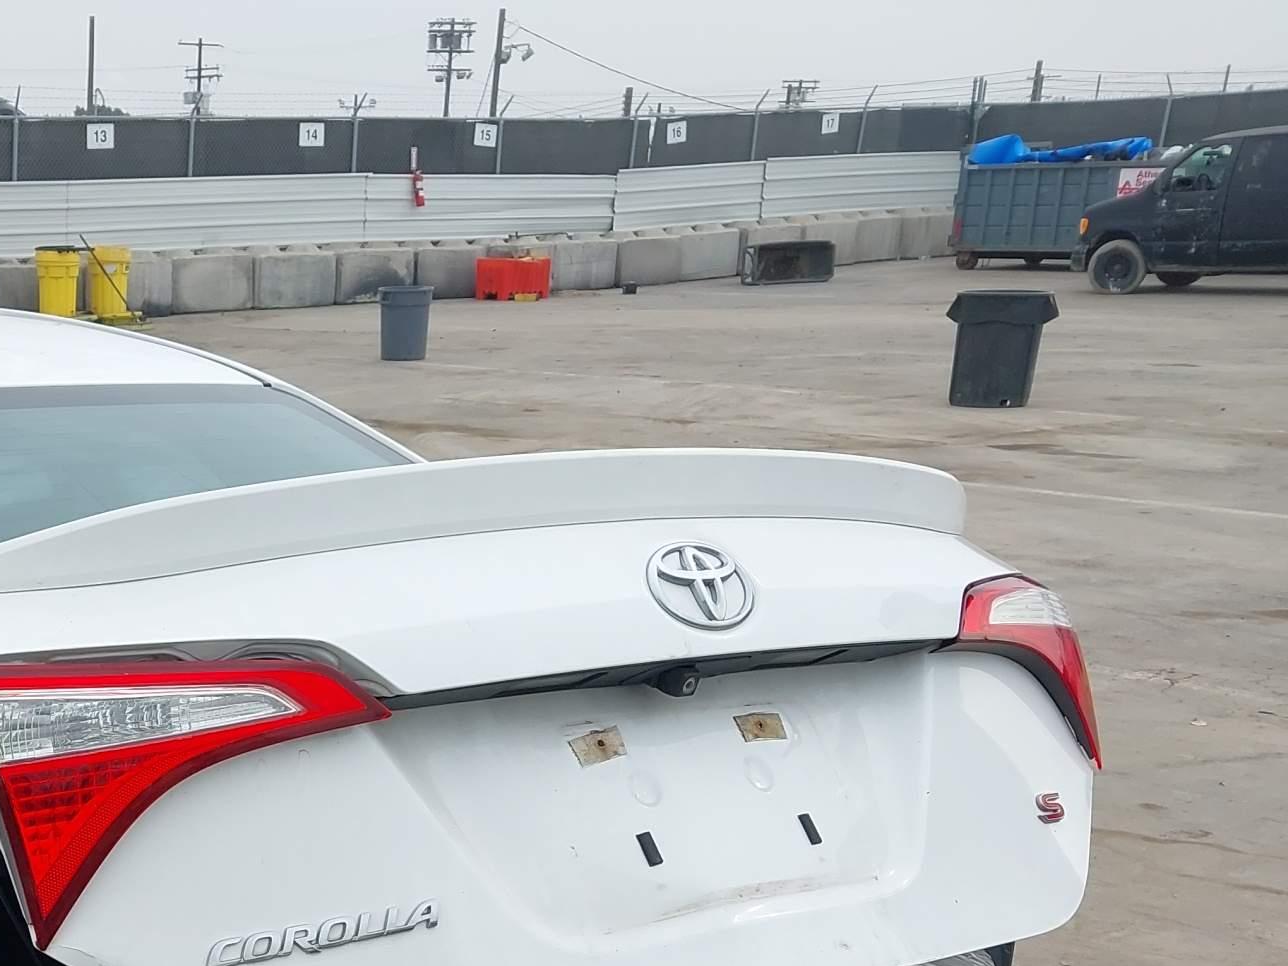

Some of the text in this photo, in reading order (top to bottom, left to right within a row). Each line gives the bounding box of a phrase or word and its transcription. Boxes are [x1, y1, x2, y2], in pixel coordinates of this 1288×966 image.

[826, 118, 835, 129] 17
[93, 129, 107, 143] 13
[305, 129, 318, 141] 14
[480, 129, 492, 141] 15
[672, 126, 682, 139] 16
[1035, 792, 1065, 825] S
